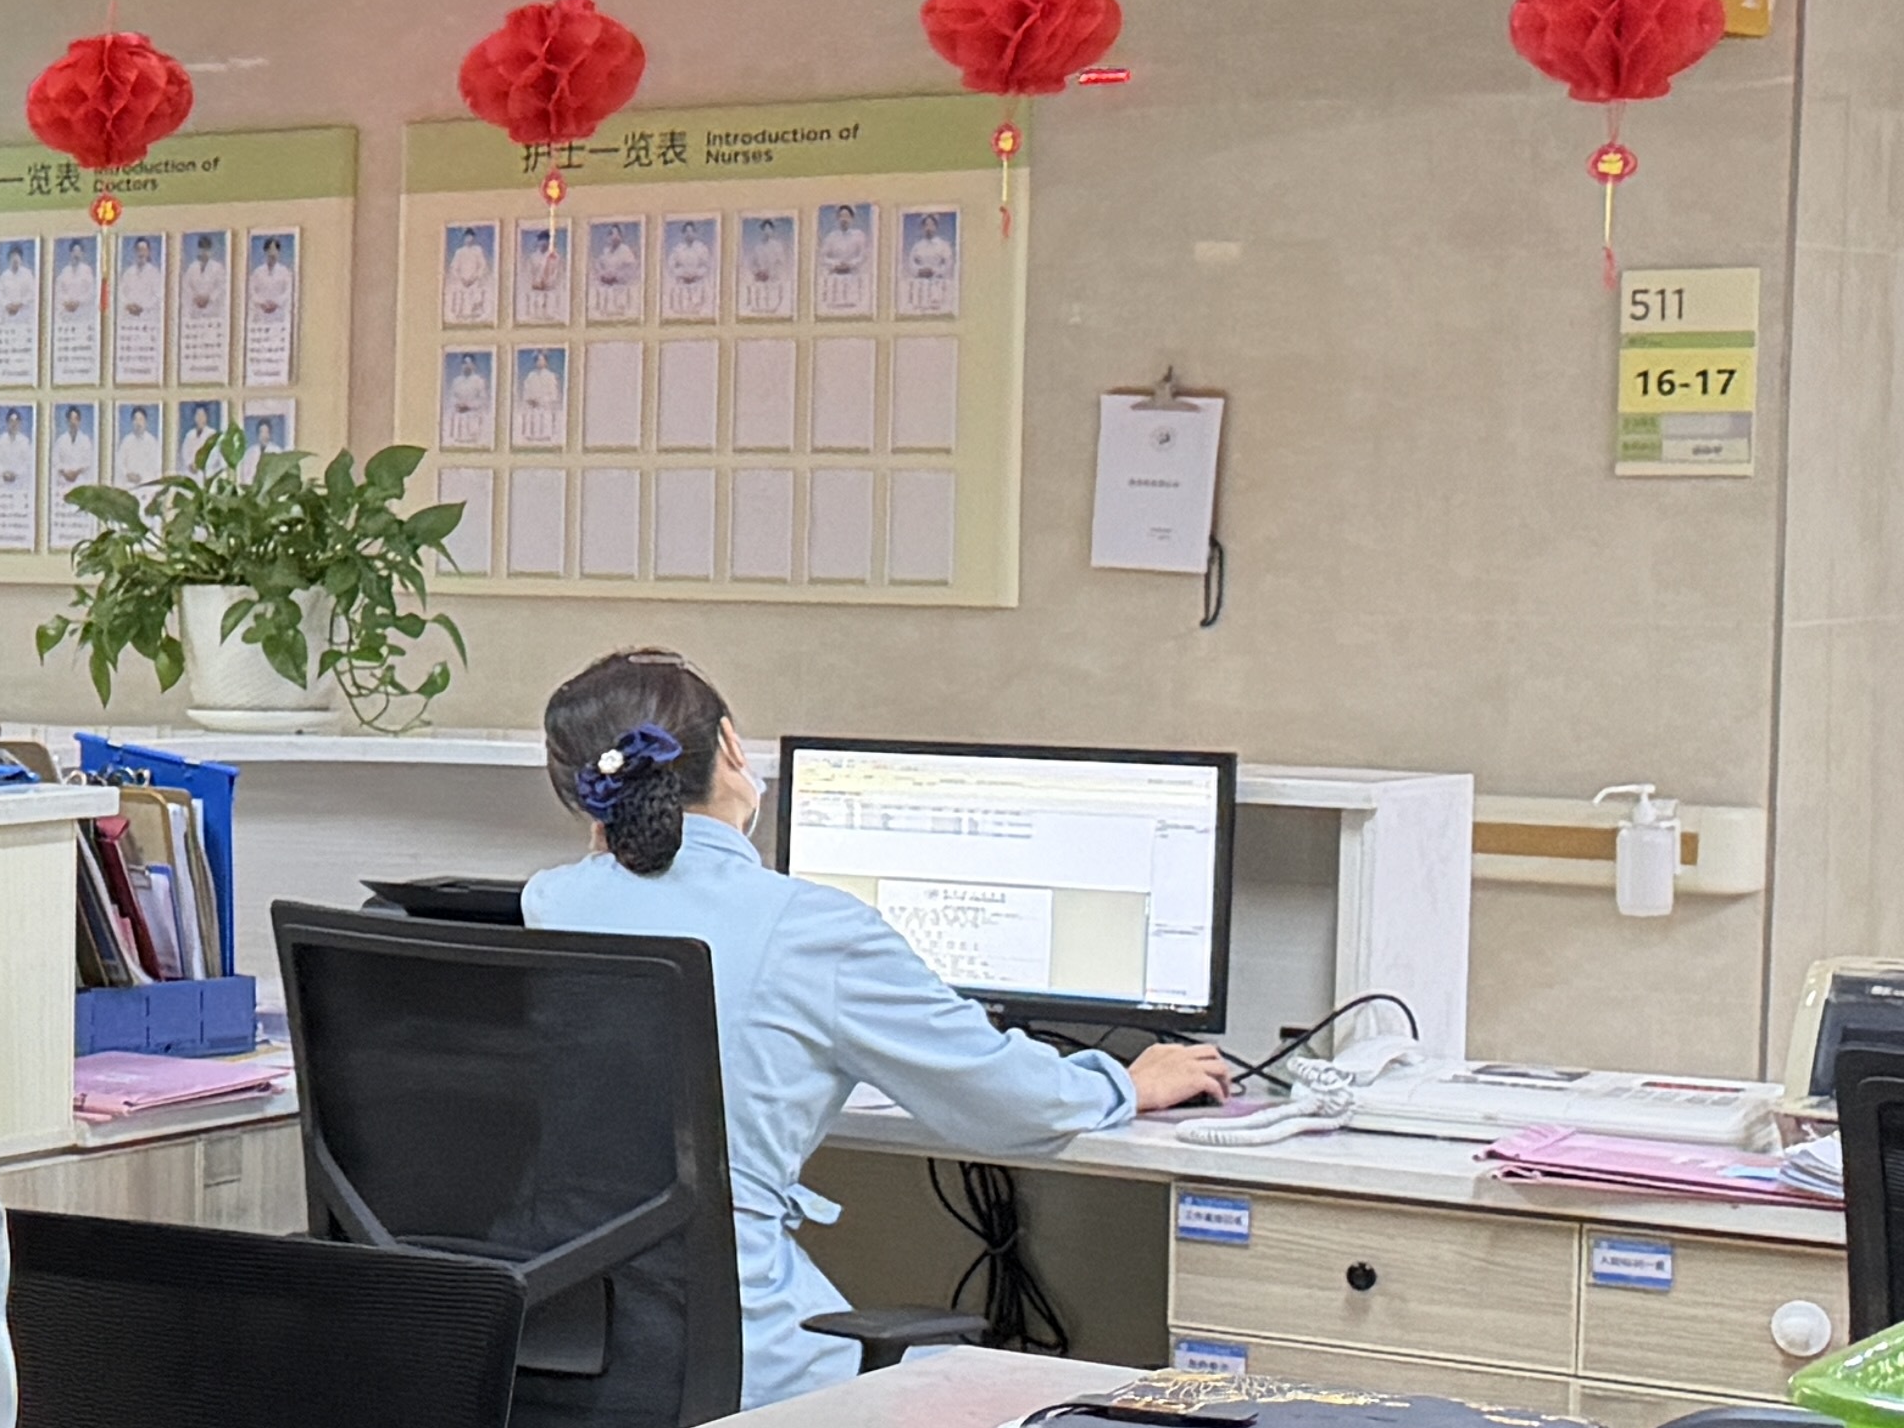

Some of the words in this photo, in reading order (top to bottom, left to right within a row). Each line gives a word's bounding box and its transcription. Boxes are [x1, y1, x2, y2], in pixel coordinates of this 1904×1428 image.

[706, 129, 831, 146] Introduction
[838, 123, 860, 140] of
[522, 131, 687, 173] 护士一览表
[705, 149, 774, 164] Nurses
[1629, 289, 1685, 322] 511
[1635, 369, 1738, 396] 16-17
